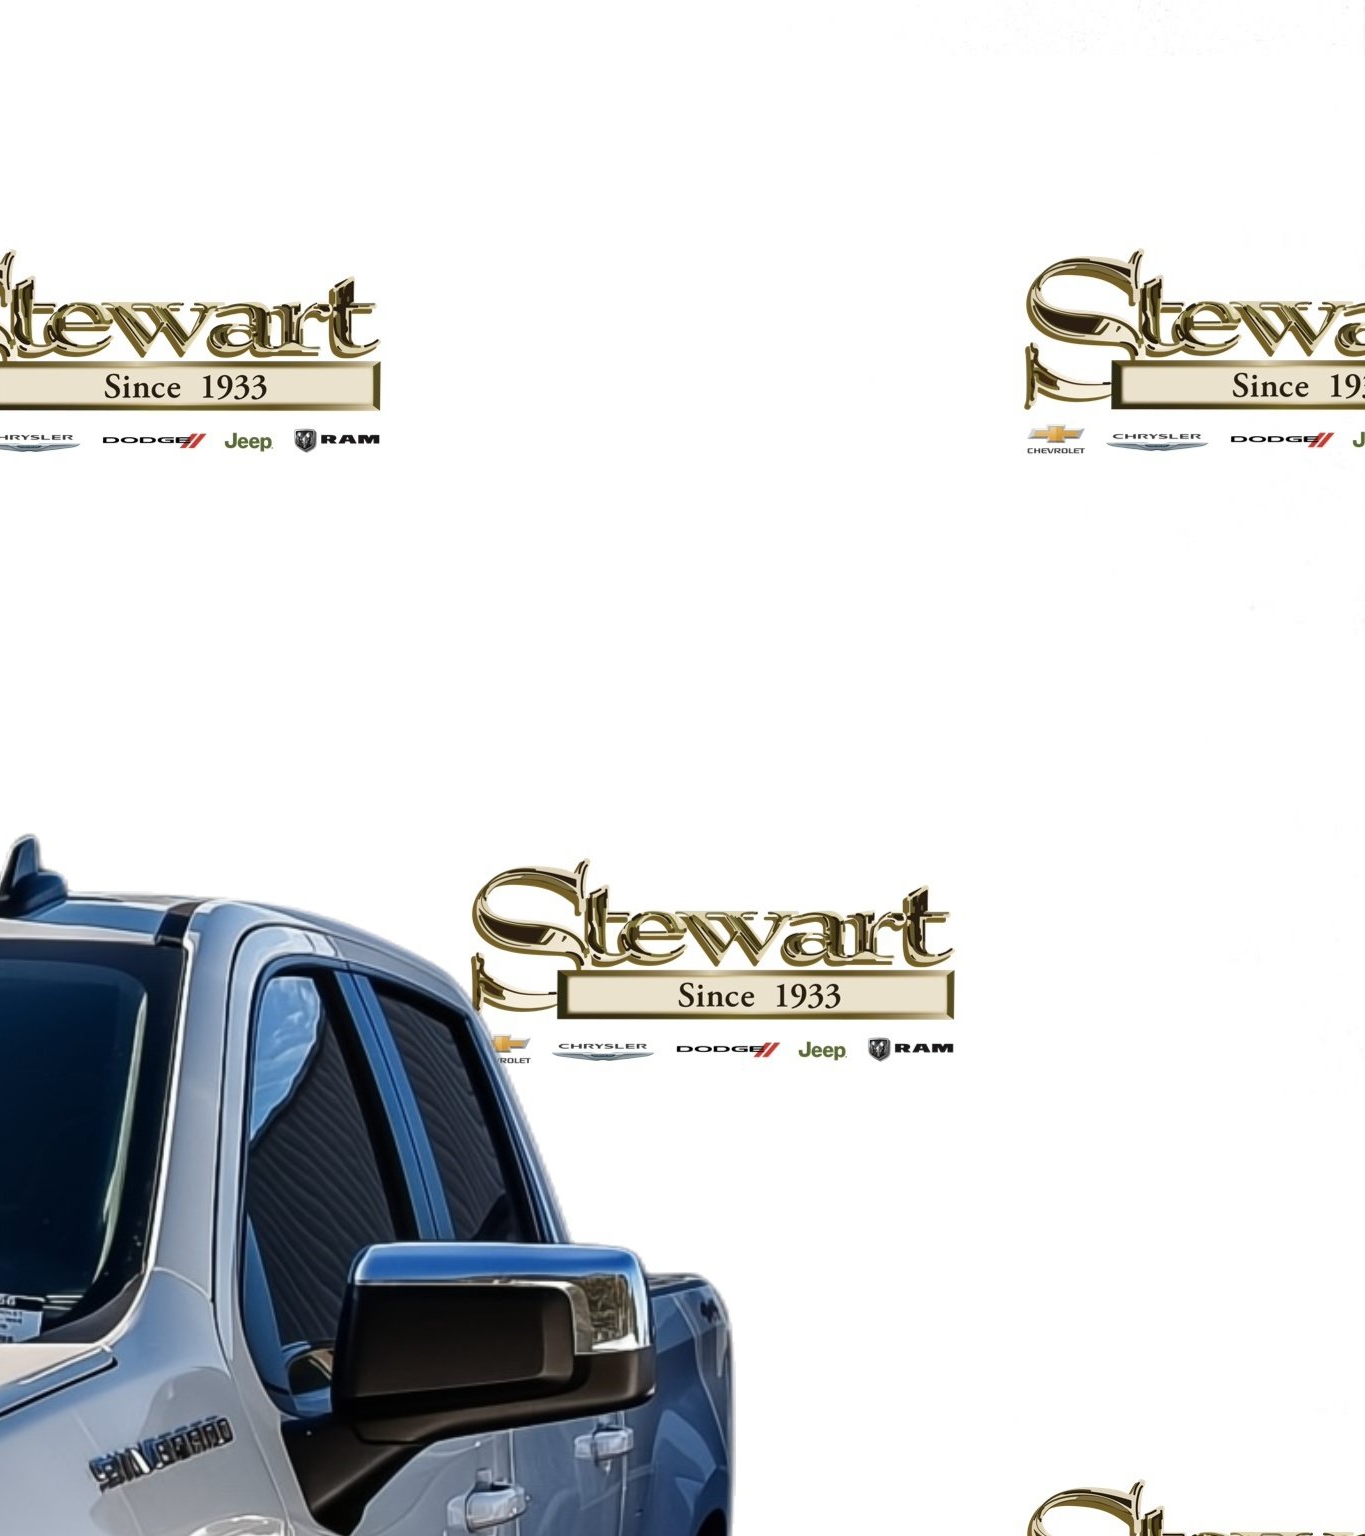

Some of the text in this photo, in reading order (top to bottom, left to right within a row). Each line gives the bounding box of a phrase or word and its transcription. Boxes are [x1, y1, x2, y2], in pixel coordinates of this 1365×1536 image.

[104, 373, 268, 400] Since 1933
[1232, 372, 1365, 399] Since 19
[102, 436, 191, 445] DODGE
[224, 432, 272, 452] Jeep
[320, 433, 381, 445] RAM
[1026, 433, 1319, 455] CHEVROLET CHRYSLER DODGE
[470, 857, 955, 1020] Stewart
[678, 982, 842, 1009] Since 1933
[558, 1043, 648, 1051] CHRYSLER
[676, 1045, 765, 1054] DODGE
[798, 1041, 846, 1061] Jeep
[894, 1042, 955, 1054] RAM
